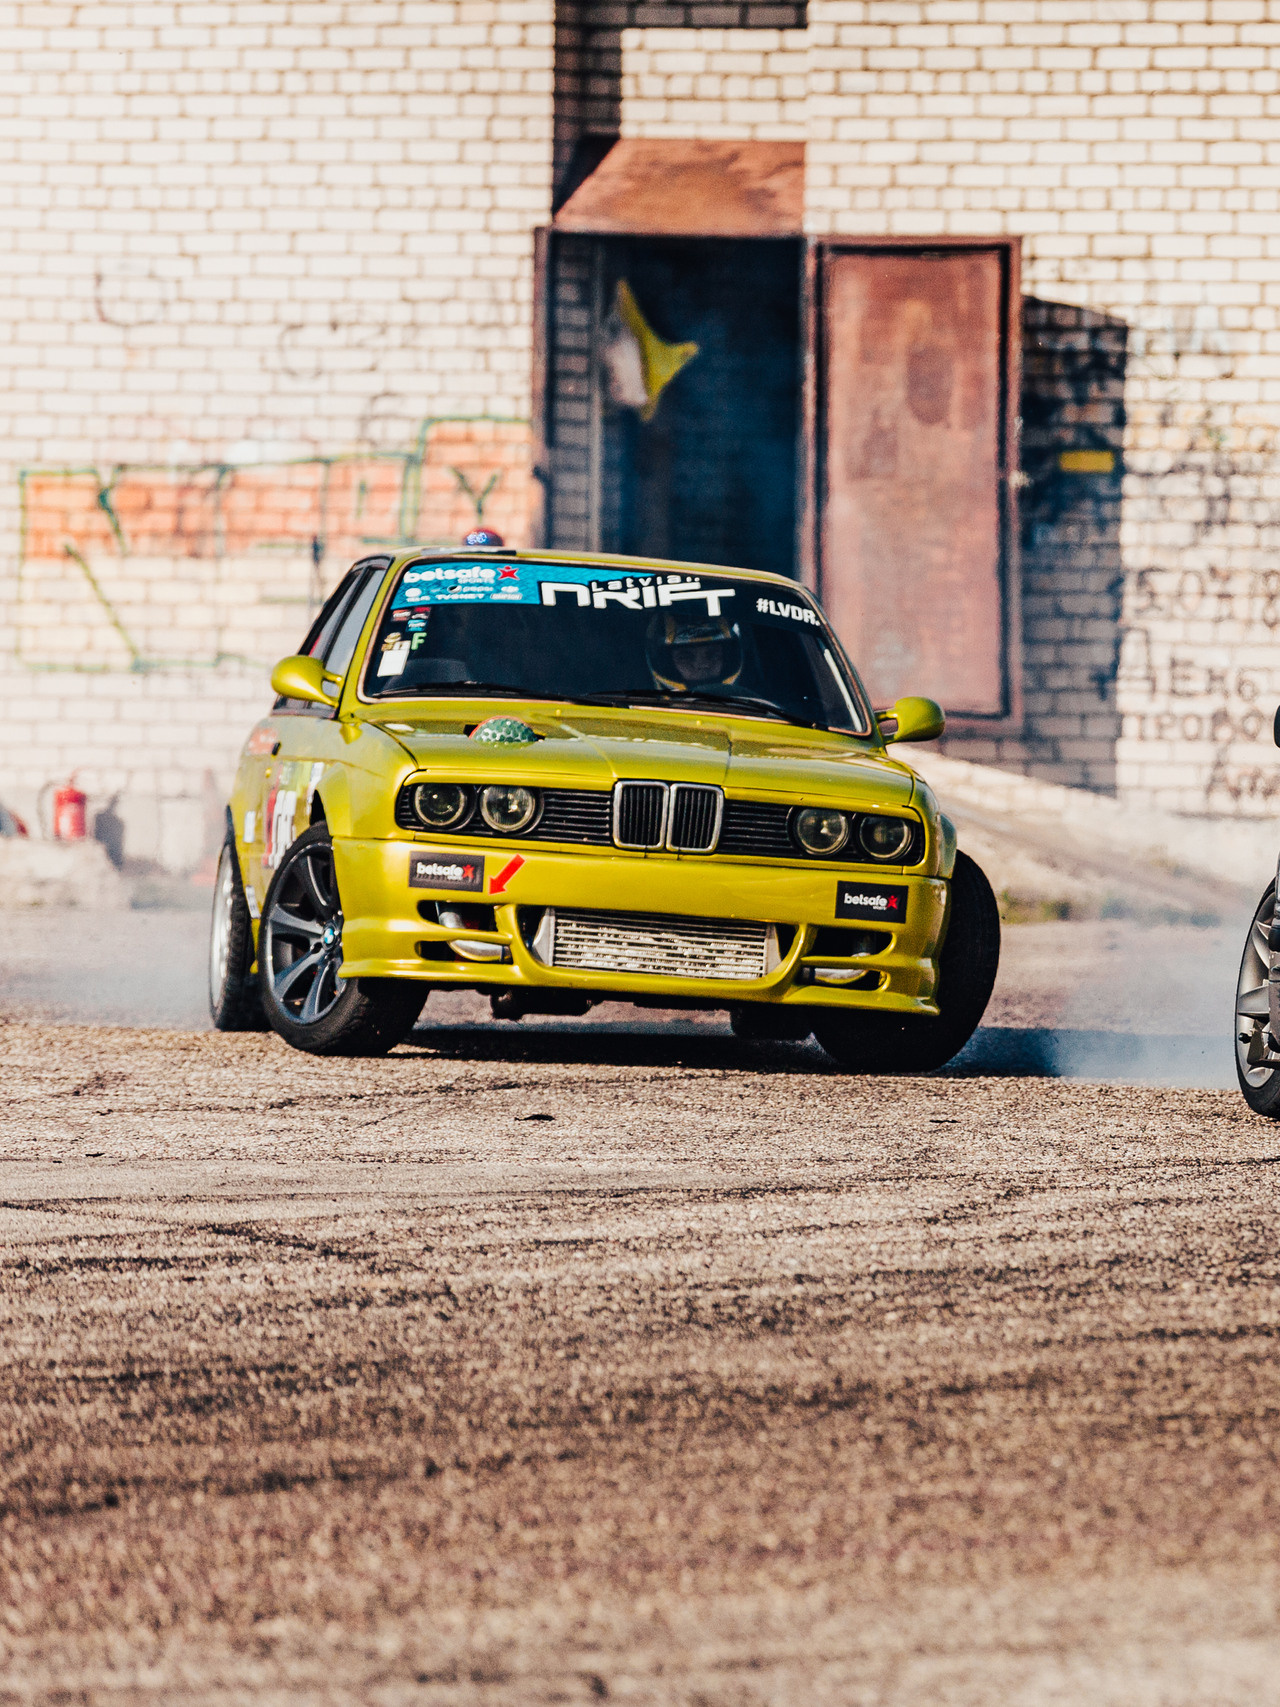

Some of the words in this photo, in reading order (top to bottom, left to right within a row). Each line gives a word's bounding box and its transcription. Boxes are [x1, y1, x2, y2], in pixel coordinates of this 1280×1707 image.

[403, 566, 496, 584] betsafe
[591, 575, 701, 593] Latvia
[411, 632, 428, 651] F
[416, 861, 464, 877] betsafe
[843, 892, 888, 907] betsafe
